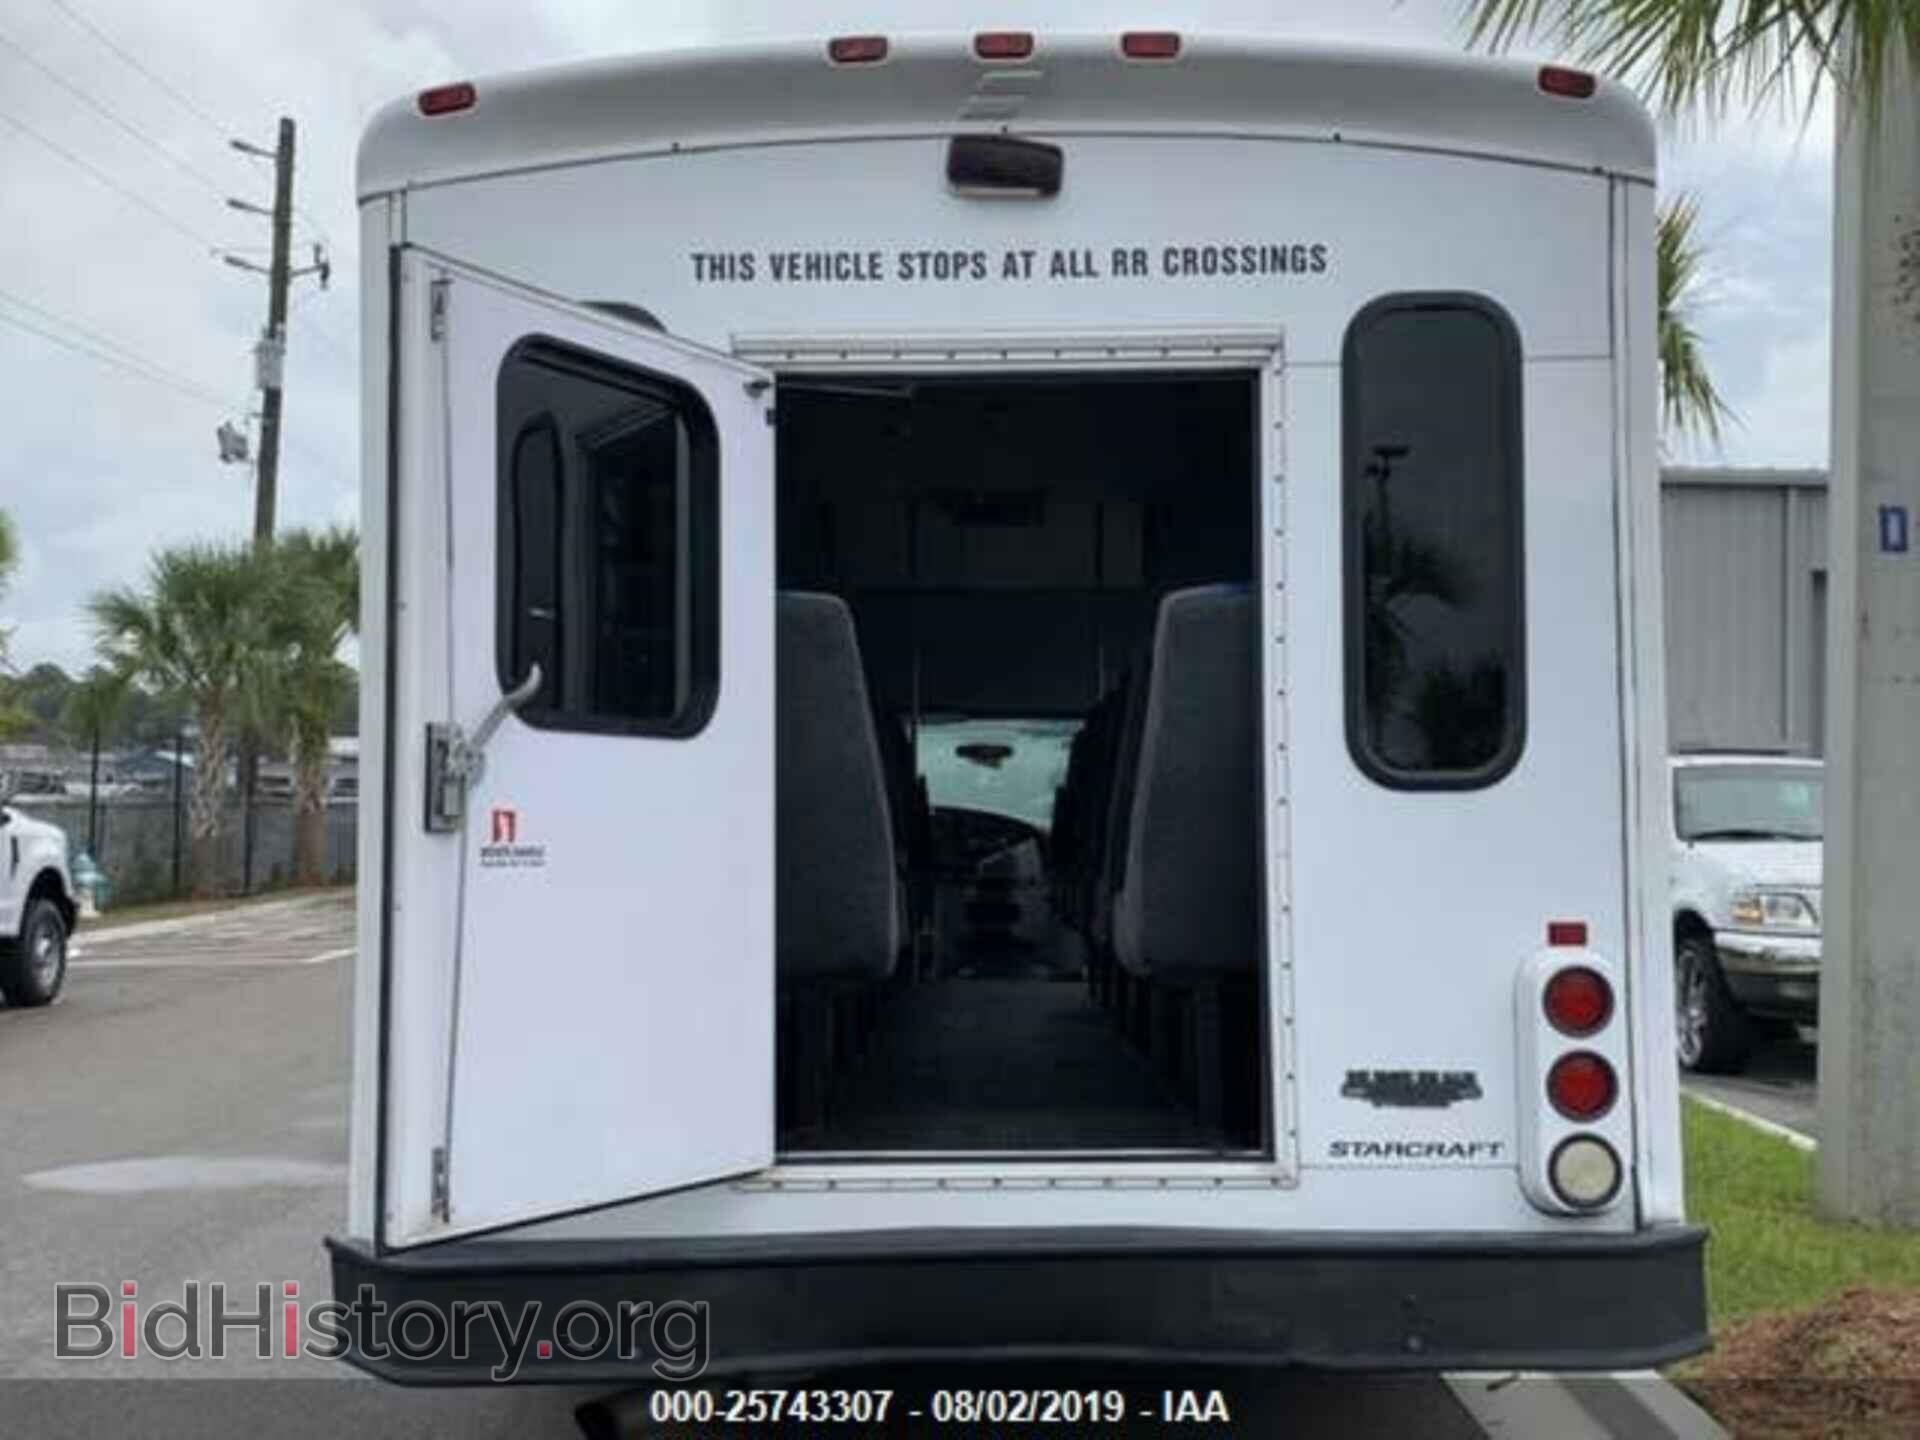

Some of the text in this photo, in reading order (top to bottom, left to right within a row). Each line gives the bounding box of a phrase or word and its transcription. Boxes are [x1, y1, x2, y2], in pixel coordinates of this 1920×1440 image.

[690, 243, 1328, 282] THIS VEHICLE STOPS AT ALL RR CROSSINGS
[1329, 1140, 1504, 1159] STARCRAFT
